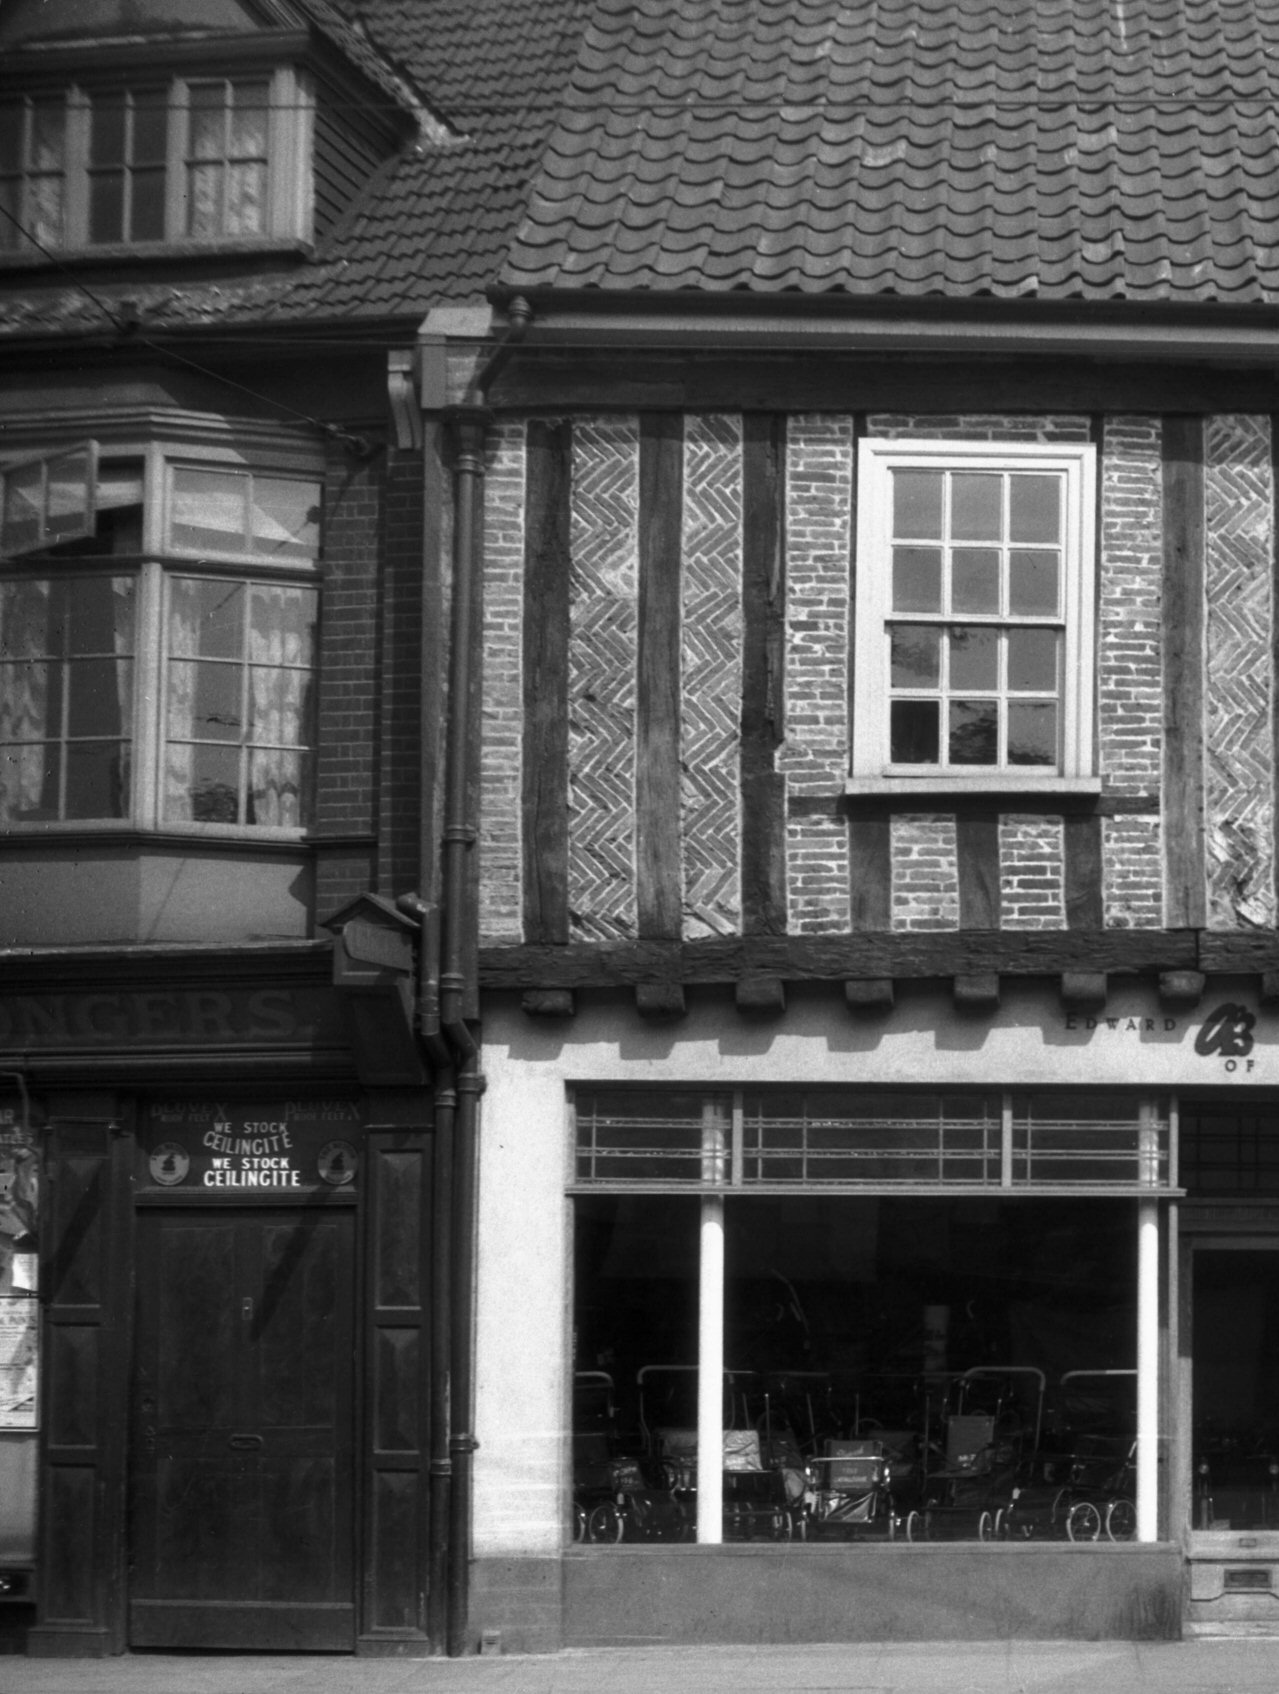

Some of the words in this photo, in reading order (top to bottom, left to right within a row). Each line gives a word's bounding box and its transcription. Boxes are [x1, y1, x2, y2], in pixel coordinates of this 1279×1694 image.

[0, 991, 297, 1037] NGERS
[1064, 1014, 1177, 1032] EDWARD
[1224, 1060, 1255, 1073] OF
[214, 1122, 232, 1133] WE
[243, 1122, 288, 1133] STOCK
[203, 1131, 293, 1155] CEILINGITE
[212, 1158, 231, 1169] WE
[241, 1158, 289, 1169] STOCK
[203, 1170, 301, 1187] CEILINGITE
